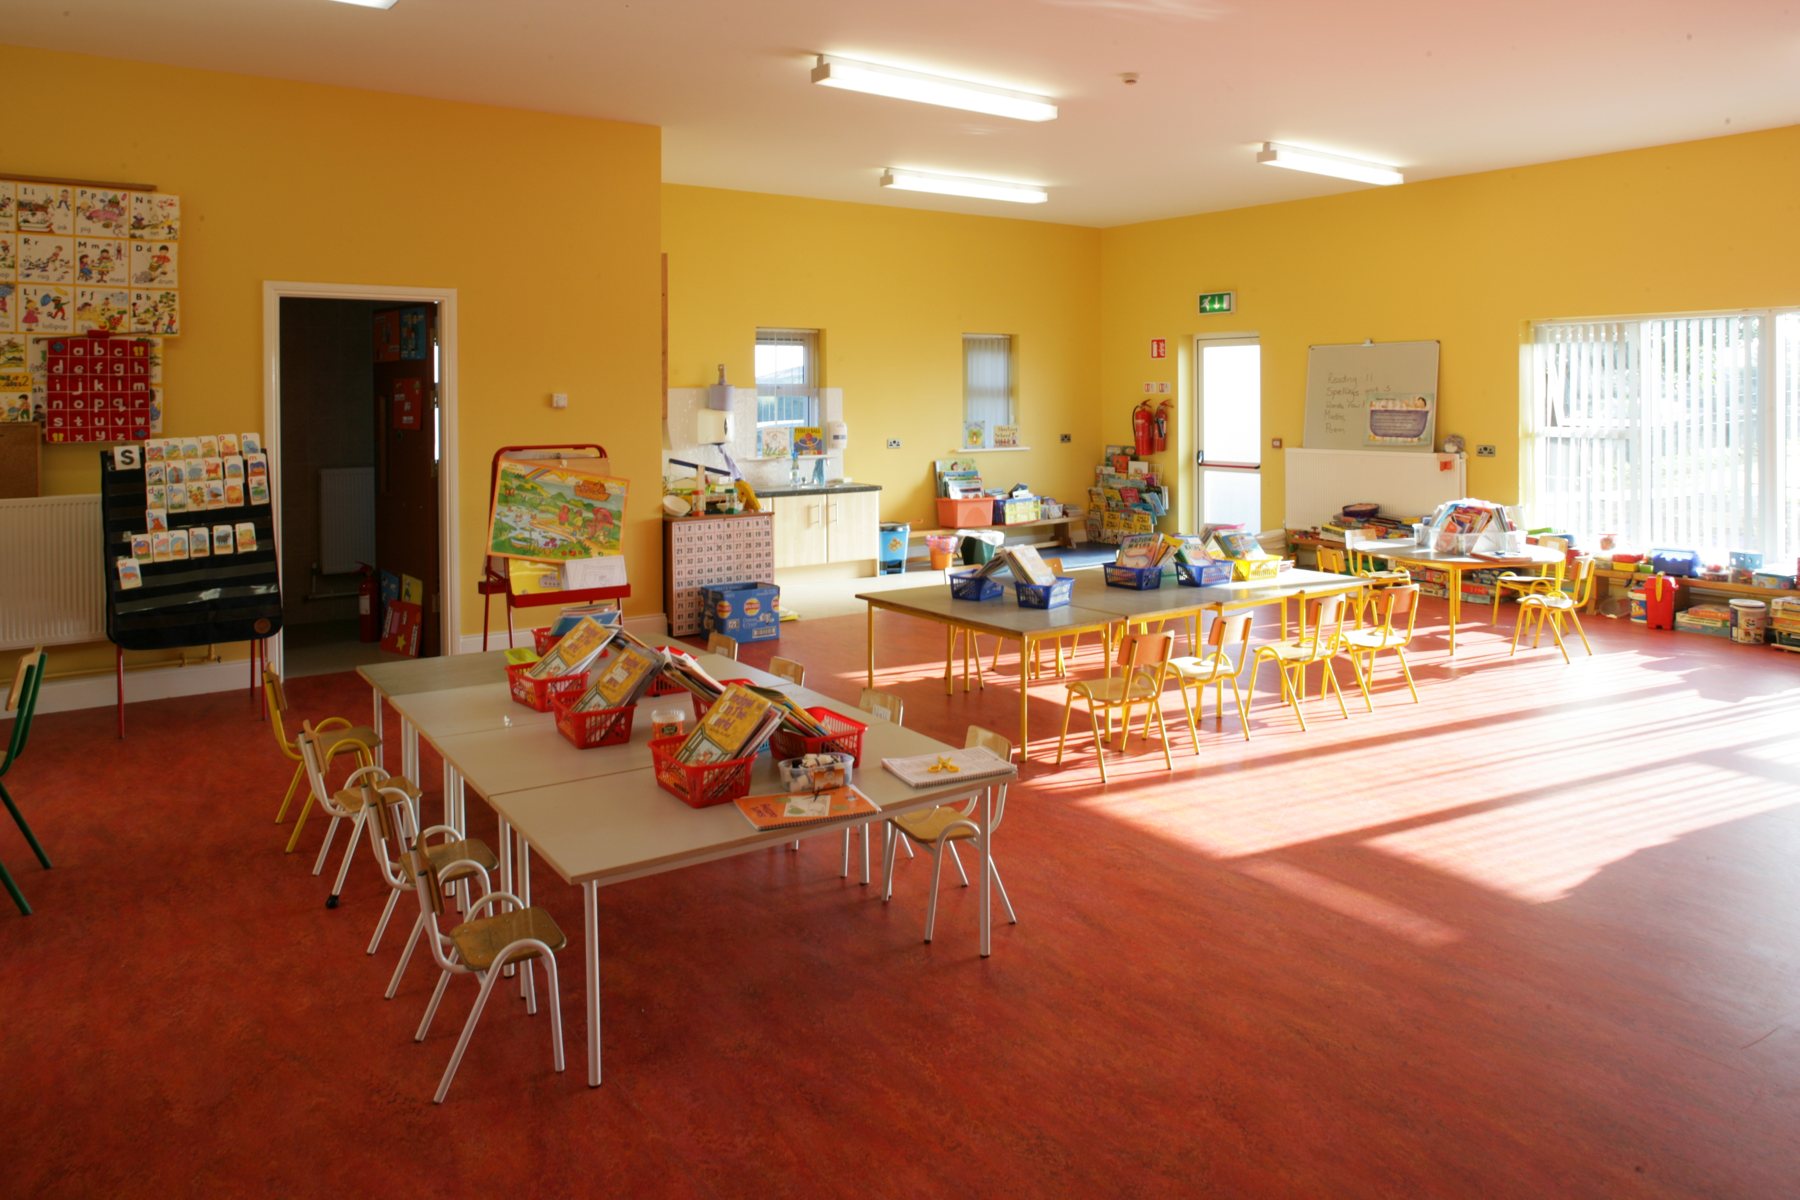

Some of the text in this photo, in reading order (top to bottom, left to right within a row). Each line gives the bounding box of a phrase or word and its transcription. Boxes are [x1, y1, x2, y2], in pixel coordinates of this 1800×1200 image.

[73, 342, 123, 356] a b c
[52, 359, 144, 376] d e f g h
[22, 375, 29, 386] 2
[56, 378, 146, 395] i j k l m
[52, 398, 144, 413] n o p q r
[53, 416, 146, 427] s t u v w
[75, 430, 125, 442] x y z
[120, 449, 135, 466] S
